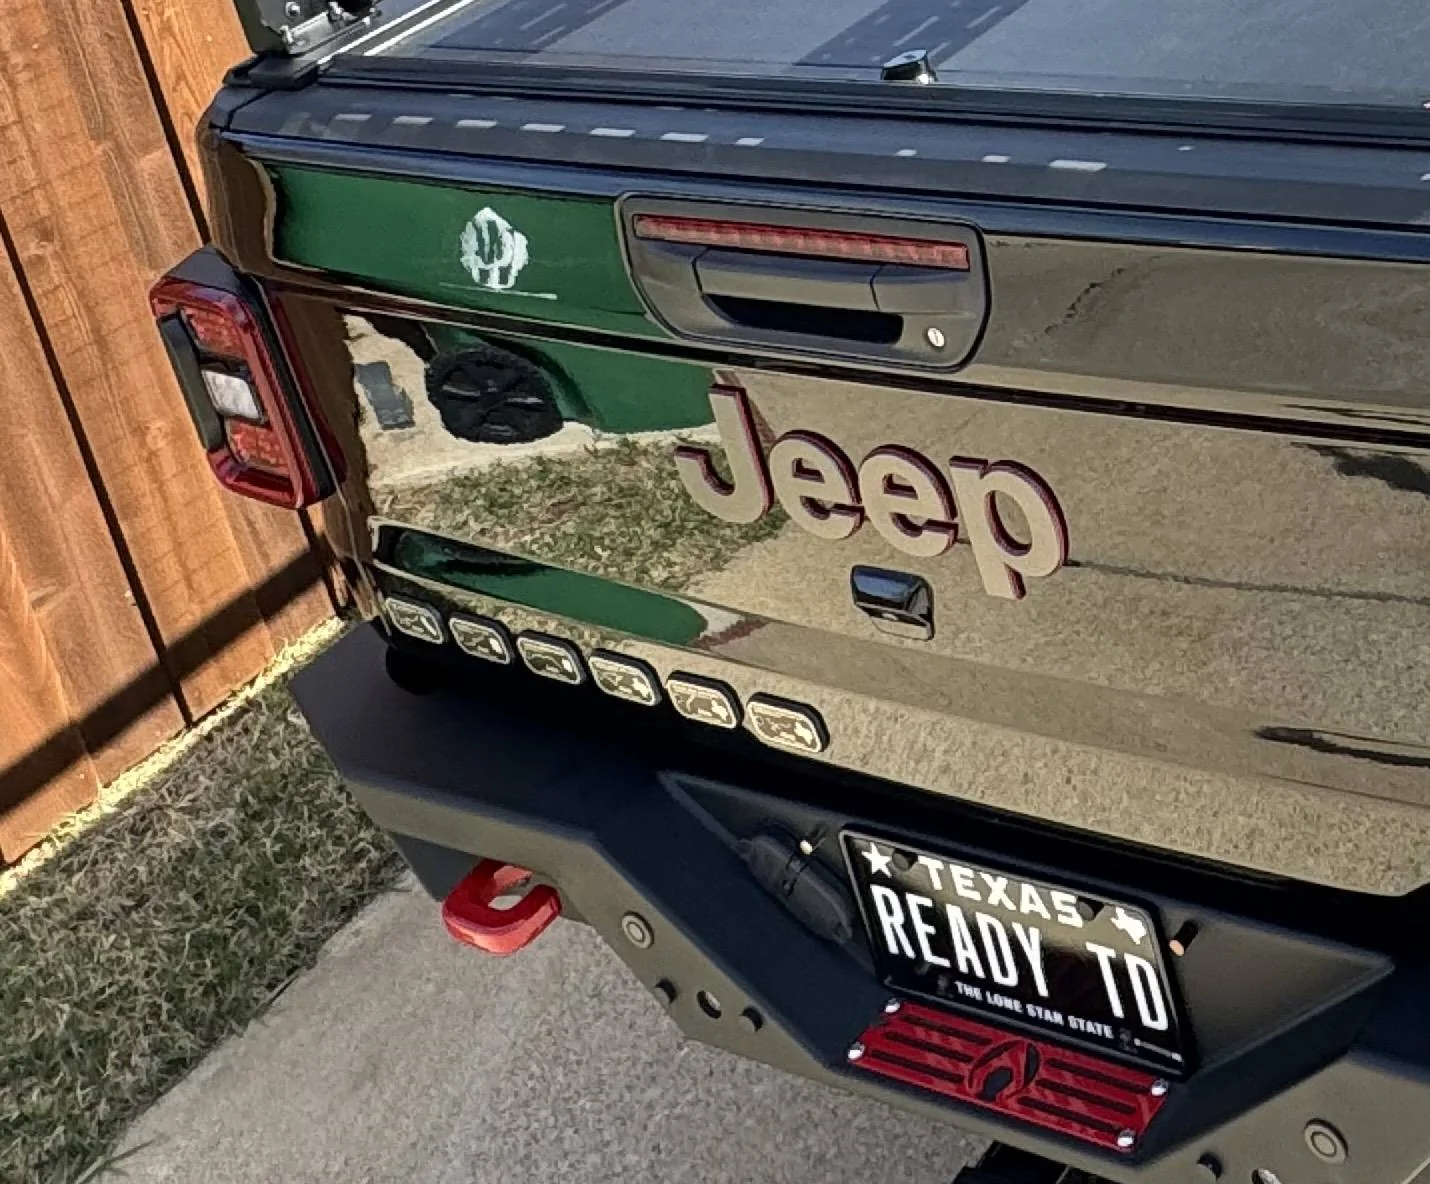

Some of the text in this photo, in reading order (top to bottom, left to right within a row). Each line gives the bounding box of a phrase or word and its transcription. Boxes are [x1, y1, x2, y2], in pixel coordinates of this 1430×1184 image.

[674, 382, 1070, 600] Jeep
[918, 854, 1083, 929] TEXAS
[869, 883, 1169, 1032] READY TD
[955, 980, 1114, 1039] THE LONE STAR STATE
